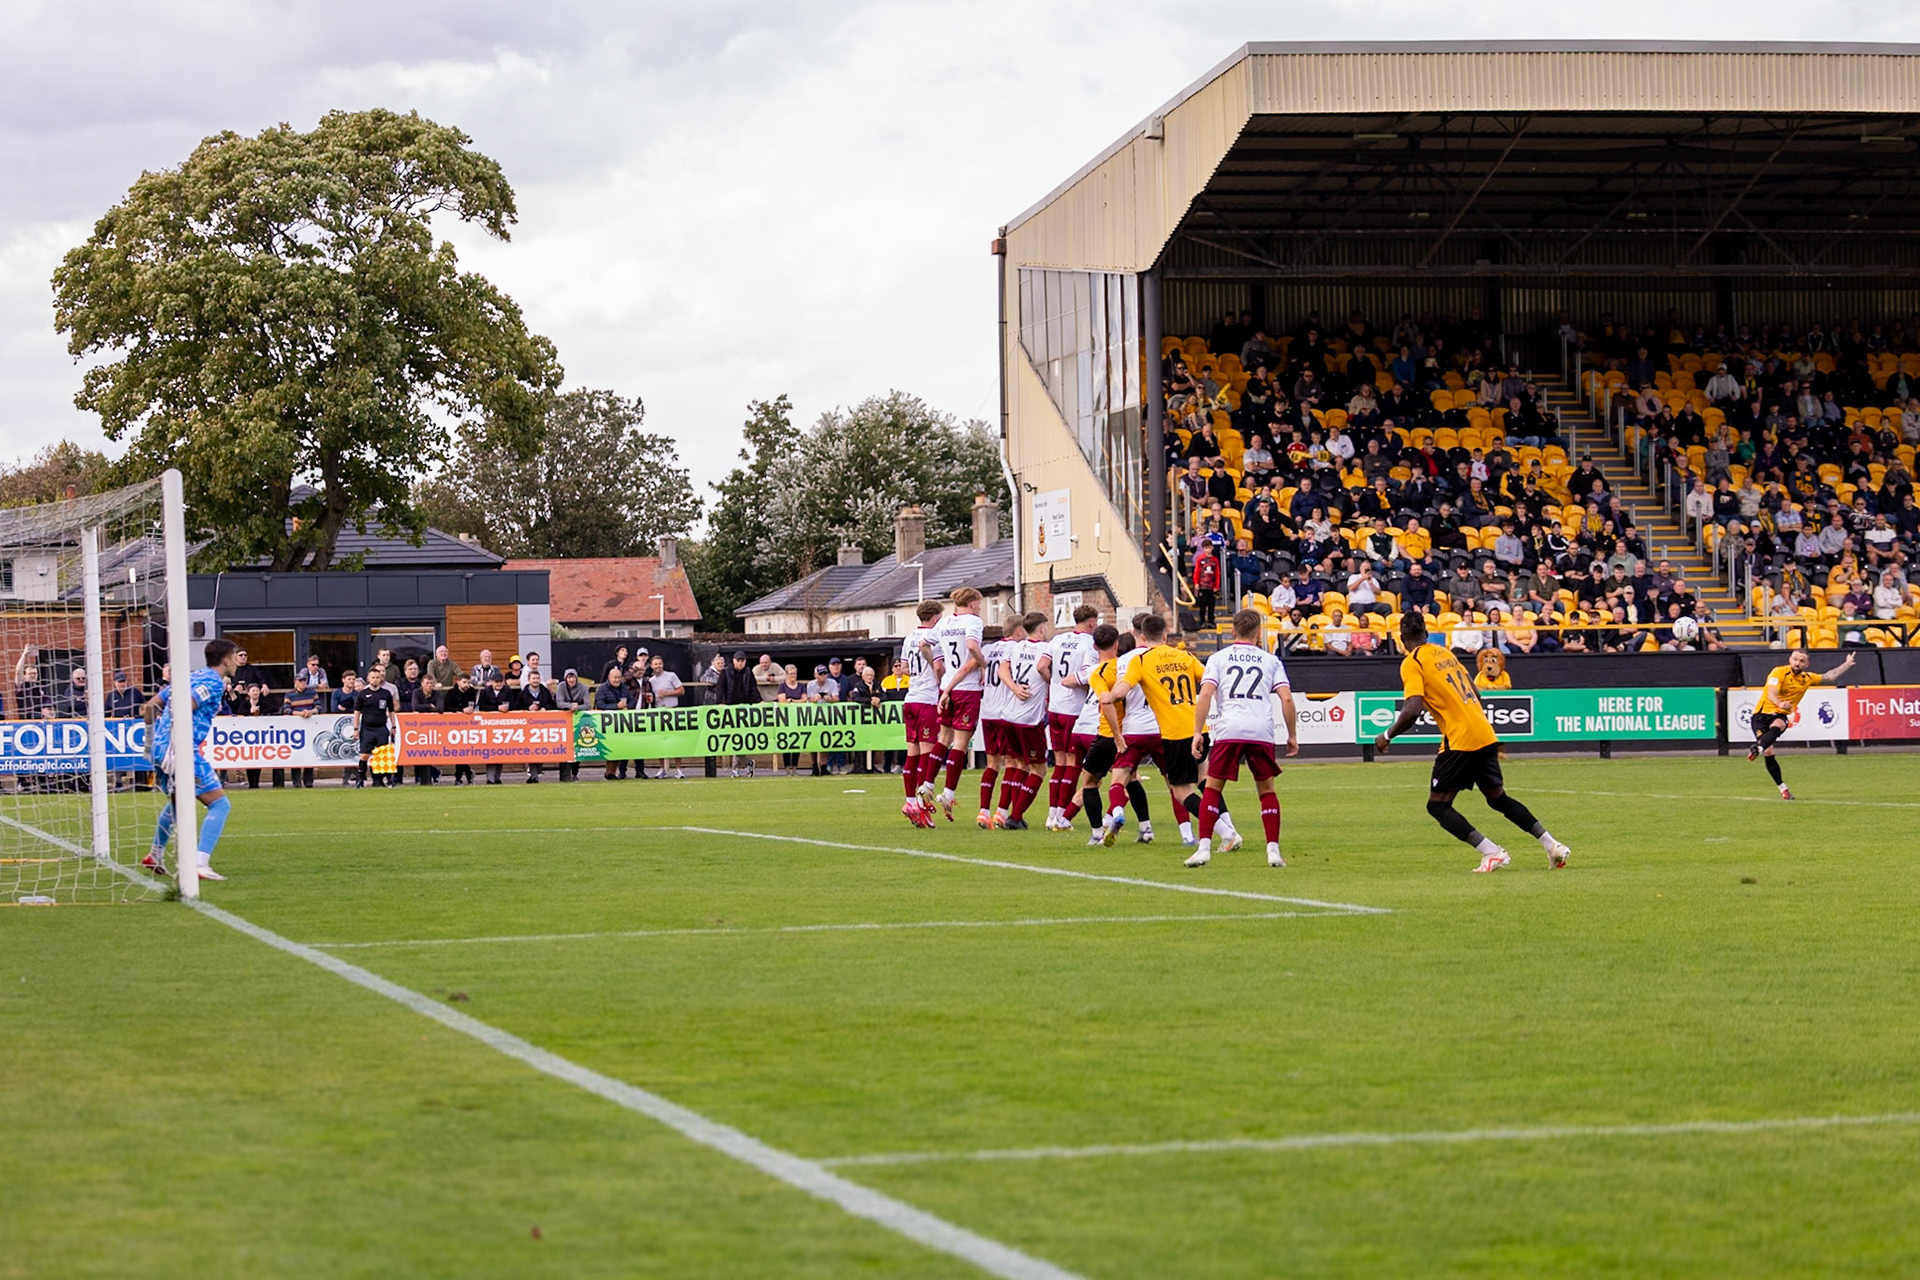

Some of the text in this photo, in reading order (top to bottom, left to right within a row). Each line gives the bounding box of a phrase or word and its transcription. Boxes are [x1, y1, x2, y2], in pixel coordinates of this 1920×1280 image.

[908, 650, 922, 676] 21
[949, 641, 961, 669] 3
[1058, 651, 1072, 679] 5
[1228, 653, 1263, 664] ALCOCK
[987, 660, 1001, 688] 10
[1156, 663, 1188, 674] BURGESS
[1160, 674, 1194, 706] 20
[1226, 665, 1263, 700] 22
[1598, 696, 1663, 713] HERE FOR
[1856, 699, 1886, 716] The
[480, 718, 527, 726] ENGINEERING
[528, 718, 567, 726] Components
[601, 702, 905, 734] PINETREE GARDEN MAINTENA
[1296, 707, 1326, 723] real
[1555, 714, 1706, 732] THE NATIONAL LEAGUE
[0, 723, 145, 755] FOLDNG
[213, 726, 305, 750] bearing
[404, 727, 567, 746] Call: 0151 374 2151
[707, 730, 856, 752] 07909 827 023
[213, 745, 292, 761] source
[406, 745, 568, 759] www.bearingsource.co.uk
